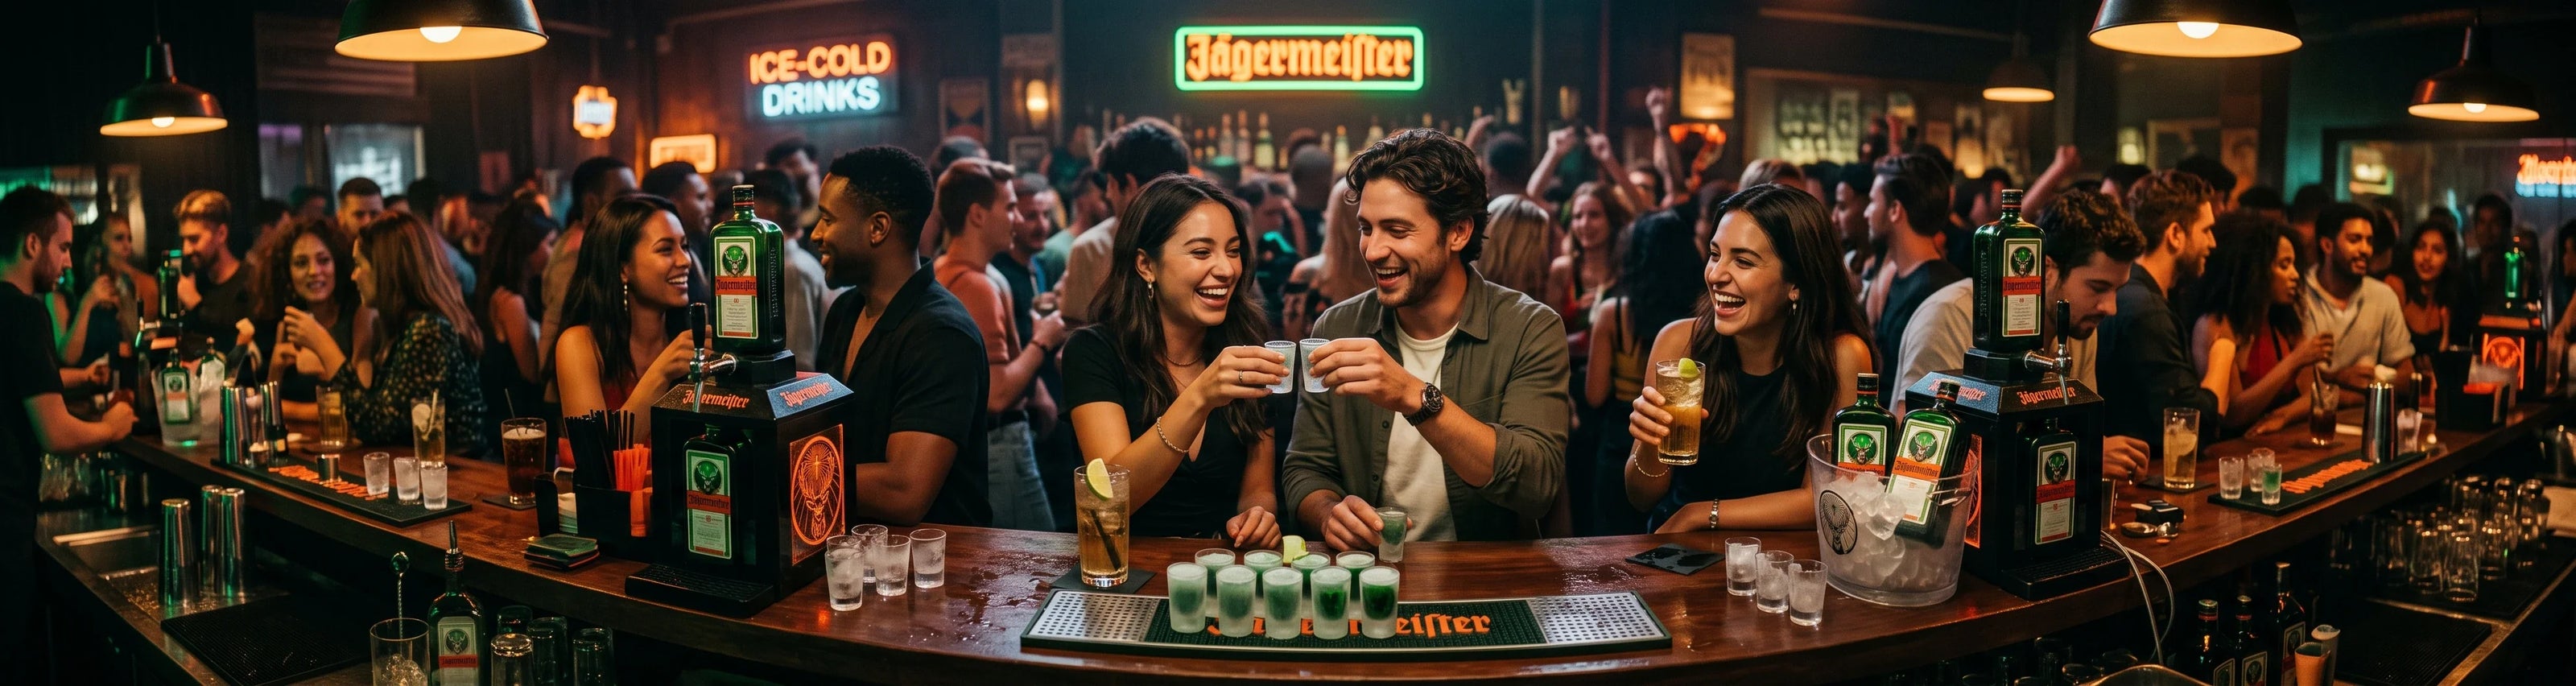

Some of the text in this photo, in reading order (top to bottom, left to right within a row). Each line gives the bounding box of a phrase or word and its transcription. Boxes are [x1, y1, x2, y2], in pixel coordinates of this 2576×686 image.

[749, 41, 891, 85] ICE-COLD
[1186, 32, 1414, 82] Jägermeister
[762, 76, 881, 117] DRINKS
